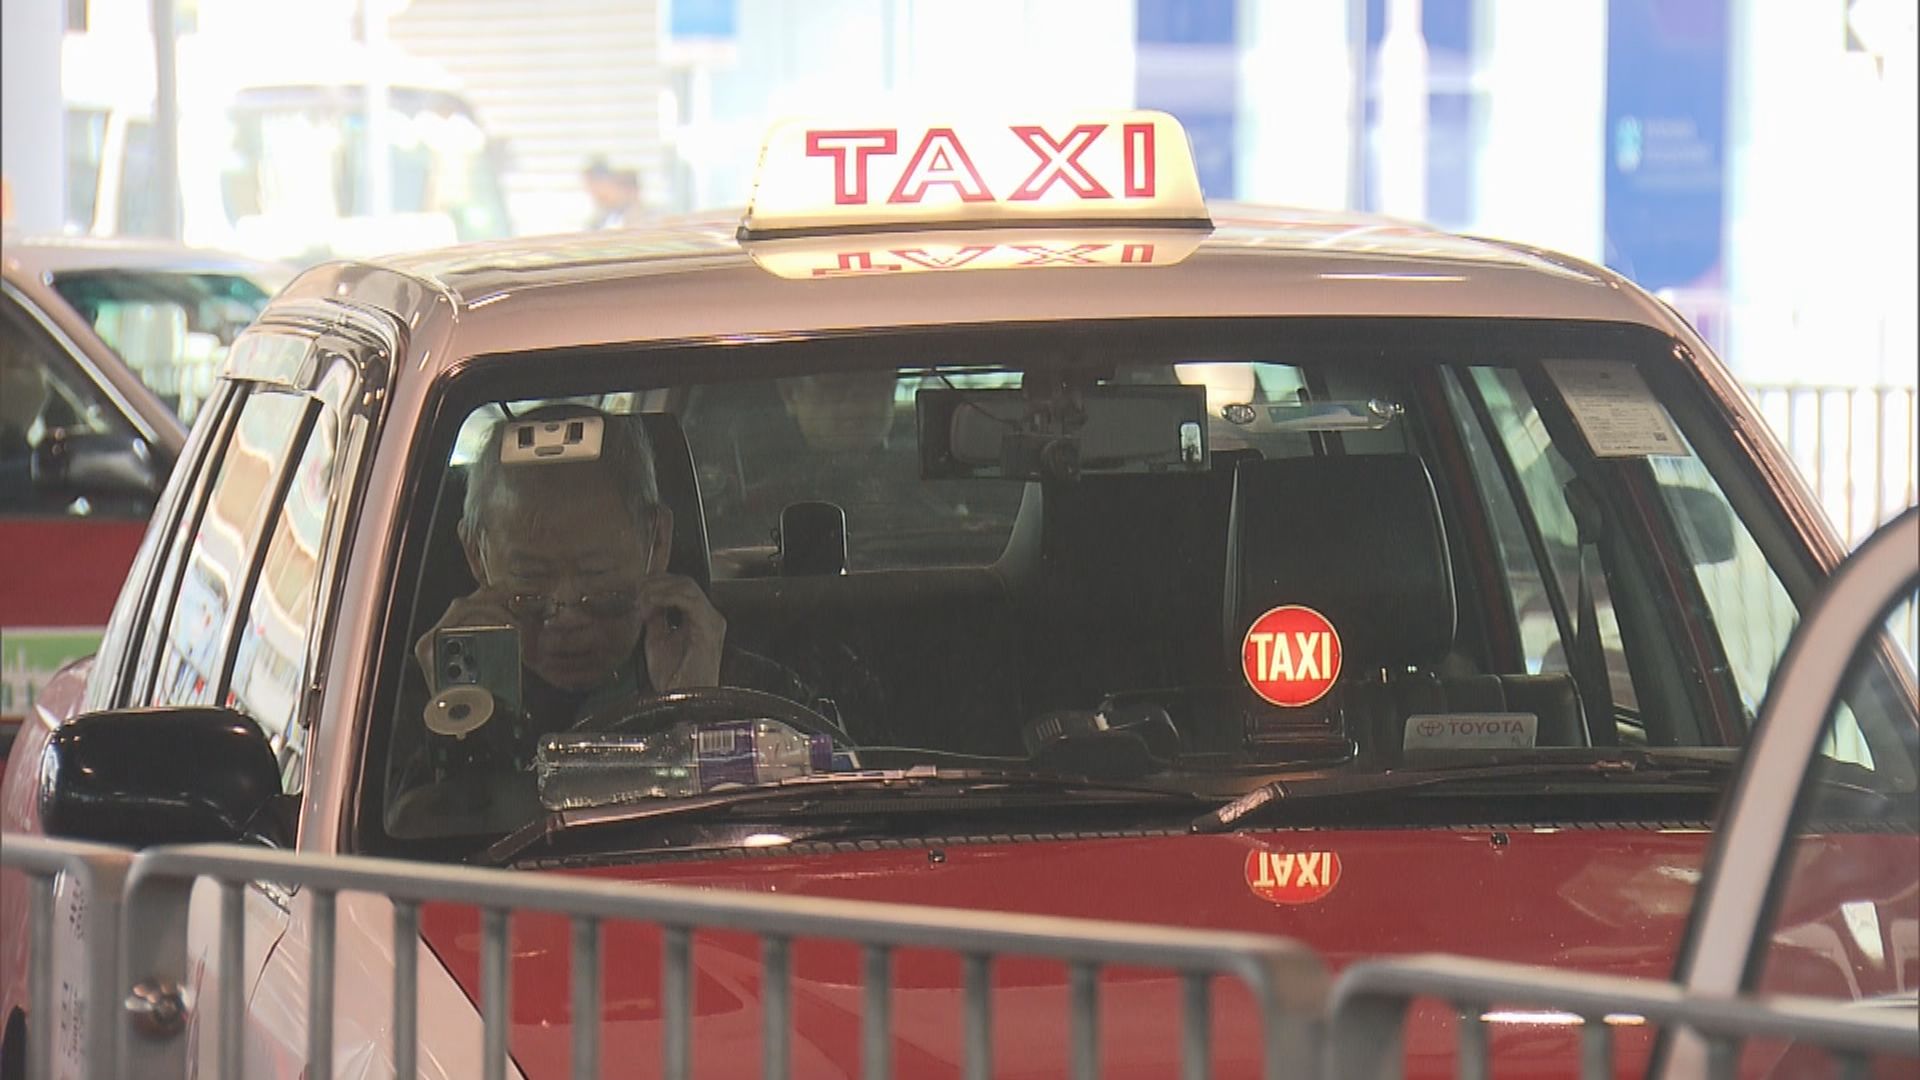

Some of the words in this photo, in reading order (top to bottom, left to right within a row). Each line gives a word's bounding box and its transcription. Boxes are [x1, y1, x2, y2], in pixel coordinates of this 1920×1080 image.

[805, 122, 1156, 205] TAXI
[1250, 631, 1331, 682] TAXI
[1448, 720, 1525, 736] TOYOTA
